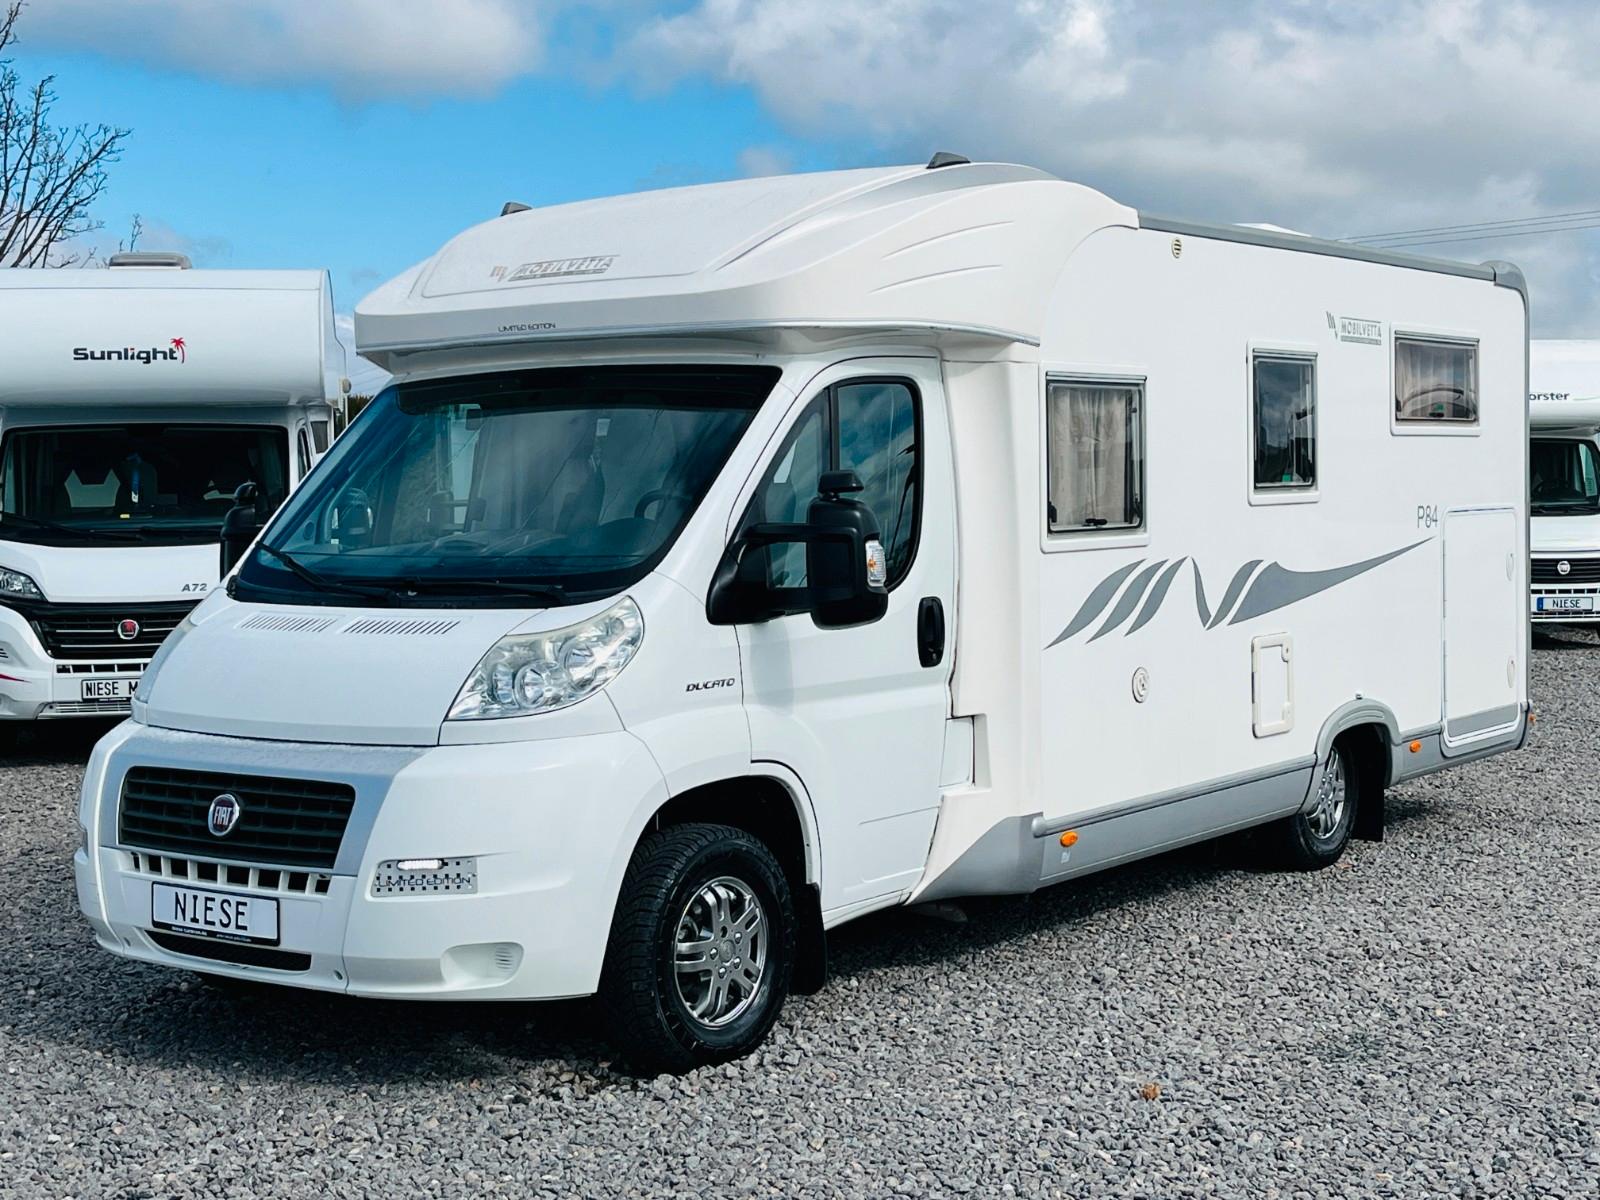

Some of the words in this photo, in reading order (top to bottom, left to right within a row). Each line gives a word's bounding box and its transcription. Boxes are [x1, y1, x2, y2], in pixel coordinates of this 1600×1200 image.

[514, 257, 614, 276] MOBILVETTA
[498, 323, 527, 333] LIMITED
[528, 322, 556, 331] EDITION
[1341, 320, 1381, 338] MOBILVETTA
[73, 346, 178, 365] Sunlight
[1529, 392, 1570, 401] orster
[1417, 505, 1439, 529] P84
[181, 582, 207, 593] A72
[1552, 599, 1581, 608] NIESE
[85, 681, 119, 697] NIESE
[128, 680, 138, 695] M
[686, 677, 735, 693] DUCATO
[213, 806, 233, 826] FIAT
[378, 878, 424, 887] LIMITED
[426, 877, 471, 886] EDITION
[175, 891, 248, 931] NIESE
